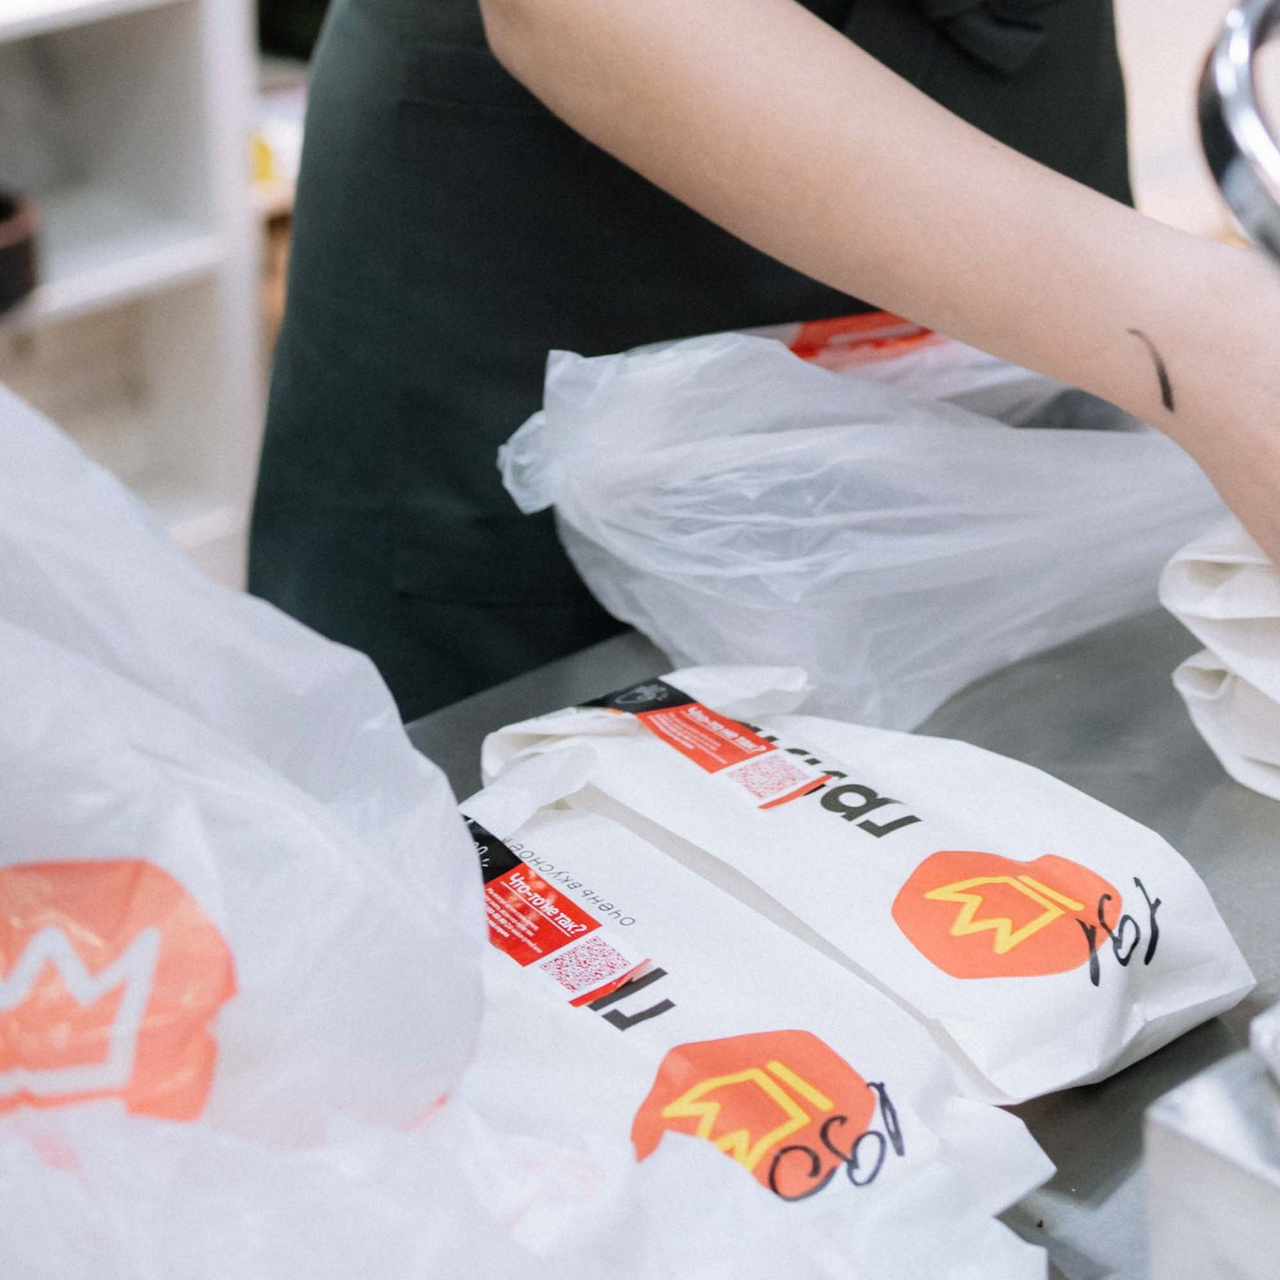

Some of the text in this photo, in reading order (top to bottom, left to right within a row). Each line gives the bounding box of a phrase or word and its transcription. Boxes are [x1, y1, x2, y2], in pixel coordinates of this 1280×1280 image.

[687, 706, 725, 732] Что-то
[509, 872, 587, 934] Что-то не так?
[582, 889, 635, 926] очень
